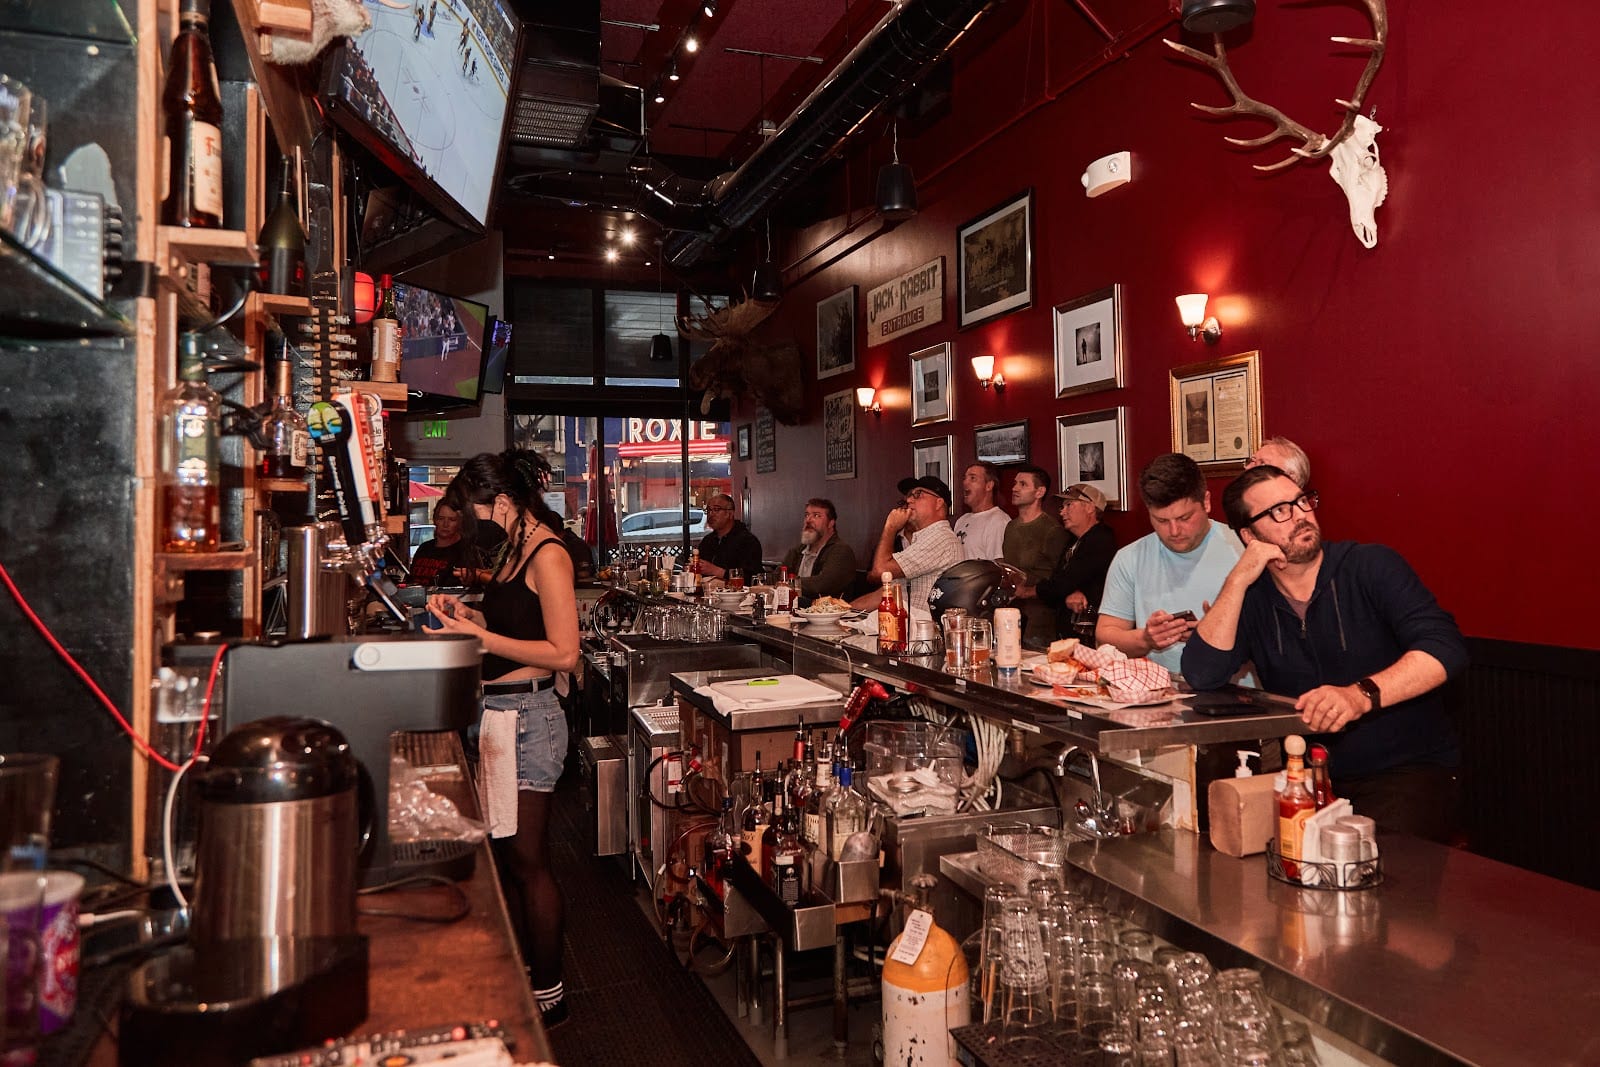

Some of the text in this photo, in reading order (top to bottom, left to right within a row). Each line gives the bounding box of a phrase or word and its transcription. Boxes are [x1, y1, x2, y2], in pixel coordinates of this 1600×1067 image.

[870, 264, 938, 323] JACK RABBIT
[882, 307, 923, 335] ENTRANCE
[424, 420, 448, 438] EXIT
[628, 417, 716, 444] ROXIE
[828, 440, 851, 461] FORBES
[831, 460, 847, 471] FIELD
